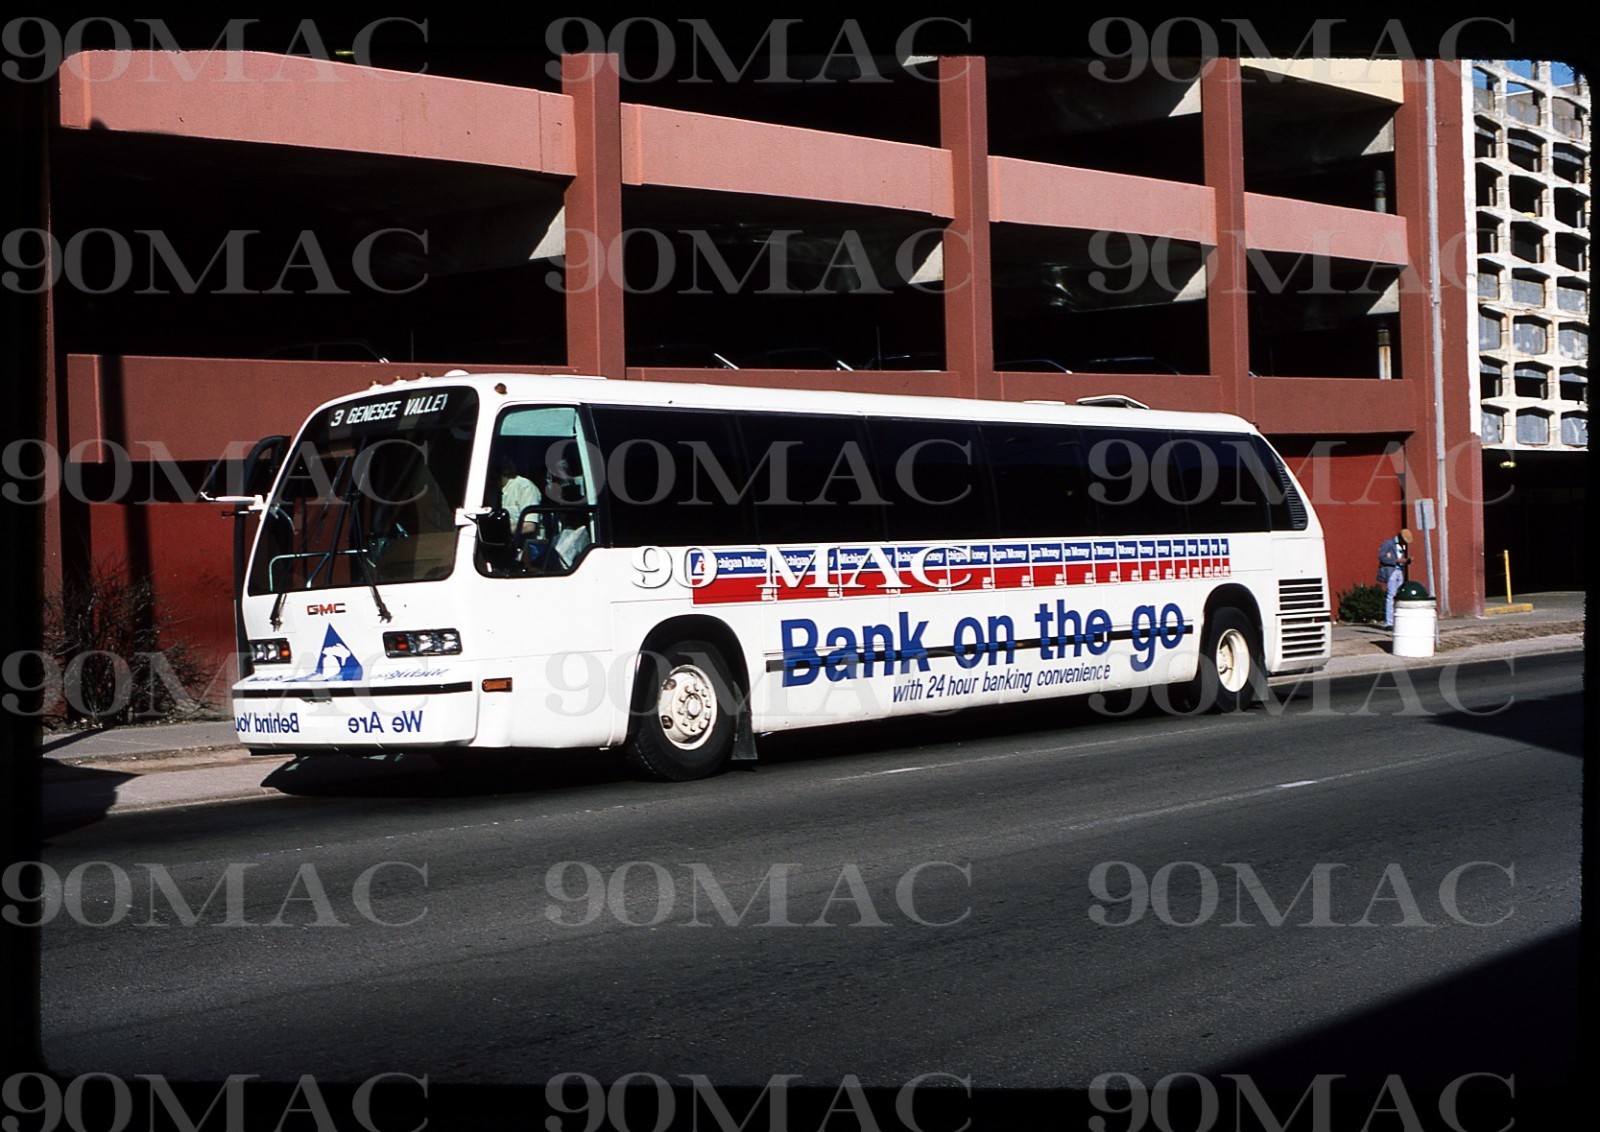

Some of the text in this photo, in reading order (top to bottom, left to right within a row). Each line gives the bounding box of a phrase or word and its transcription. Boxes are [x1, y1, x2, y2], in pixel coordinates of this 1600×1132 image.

[331, 409, 345, 427] 3
[346, 400, 402, 425] GENESEE
[1006, 548, 1027, 561] Money
[1040, 547, 1060, 560] Money
[307, 603, 346, 616] GMC
[780, 598, 1186, 688] Bank on the go
[892, 663, 1111, 703] with 24 hour banking convenience
